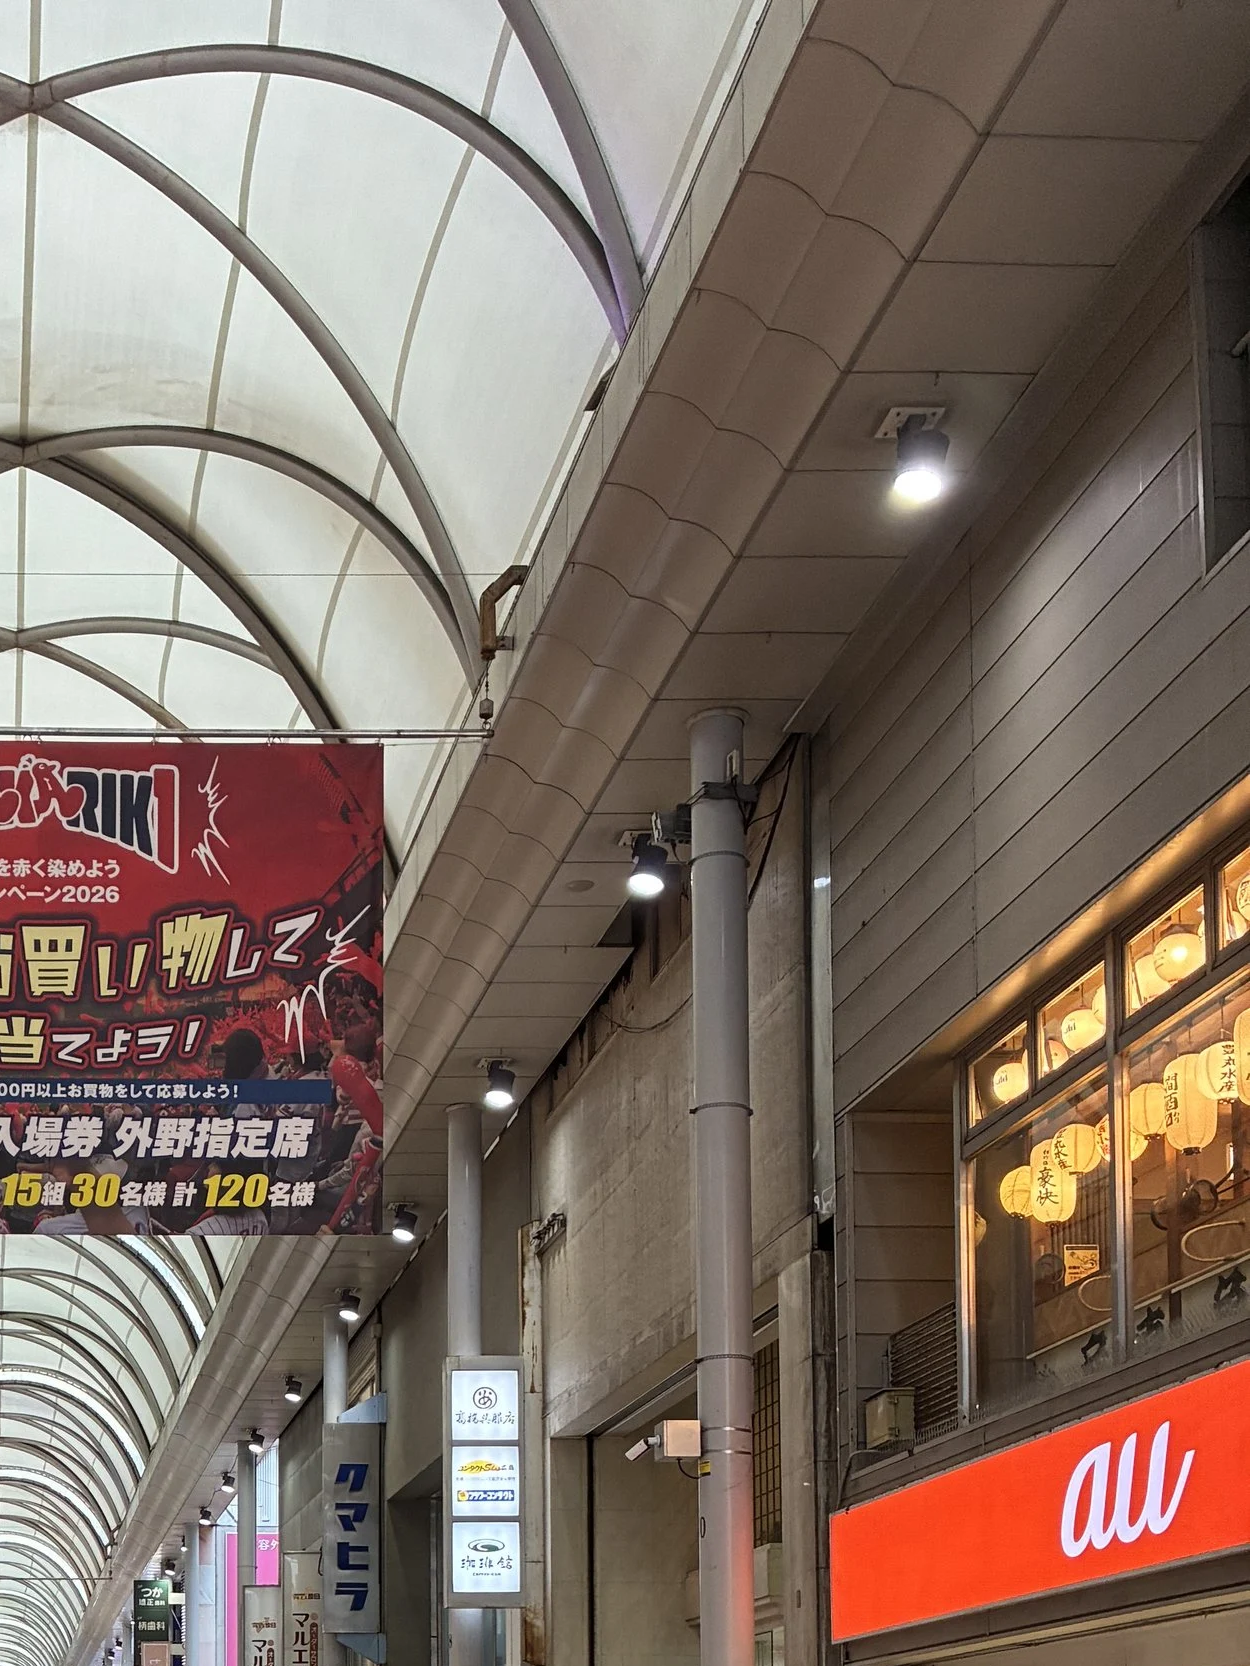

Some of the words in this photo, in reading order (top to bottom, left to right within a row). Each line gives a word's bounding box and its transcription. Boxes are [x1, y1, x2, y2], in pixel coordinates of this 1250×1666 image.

[113, 1116, 316, 1160] 外野指定席
[0, 1173, 66, 1208] 15組
[69, 1172, 167, 1208] 30名様
[172, 1179, 195, 1208] 計
[203, 1172, 316, 1209] 120名様
[1035, 1166, 1061, 1207] 豪快
[1060, 1420, 1196, 1558] au
[334, 1463, 370, 1612] クマヒラ
[460, 1555, 514, 1571] 珈琲館
[141, 1586, 164, 1598] つか
